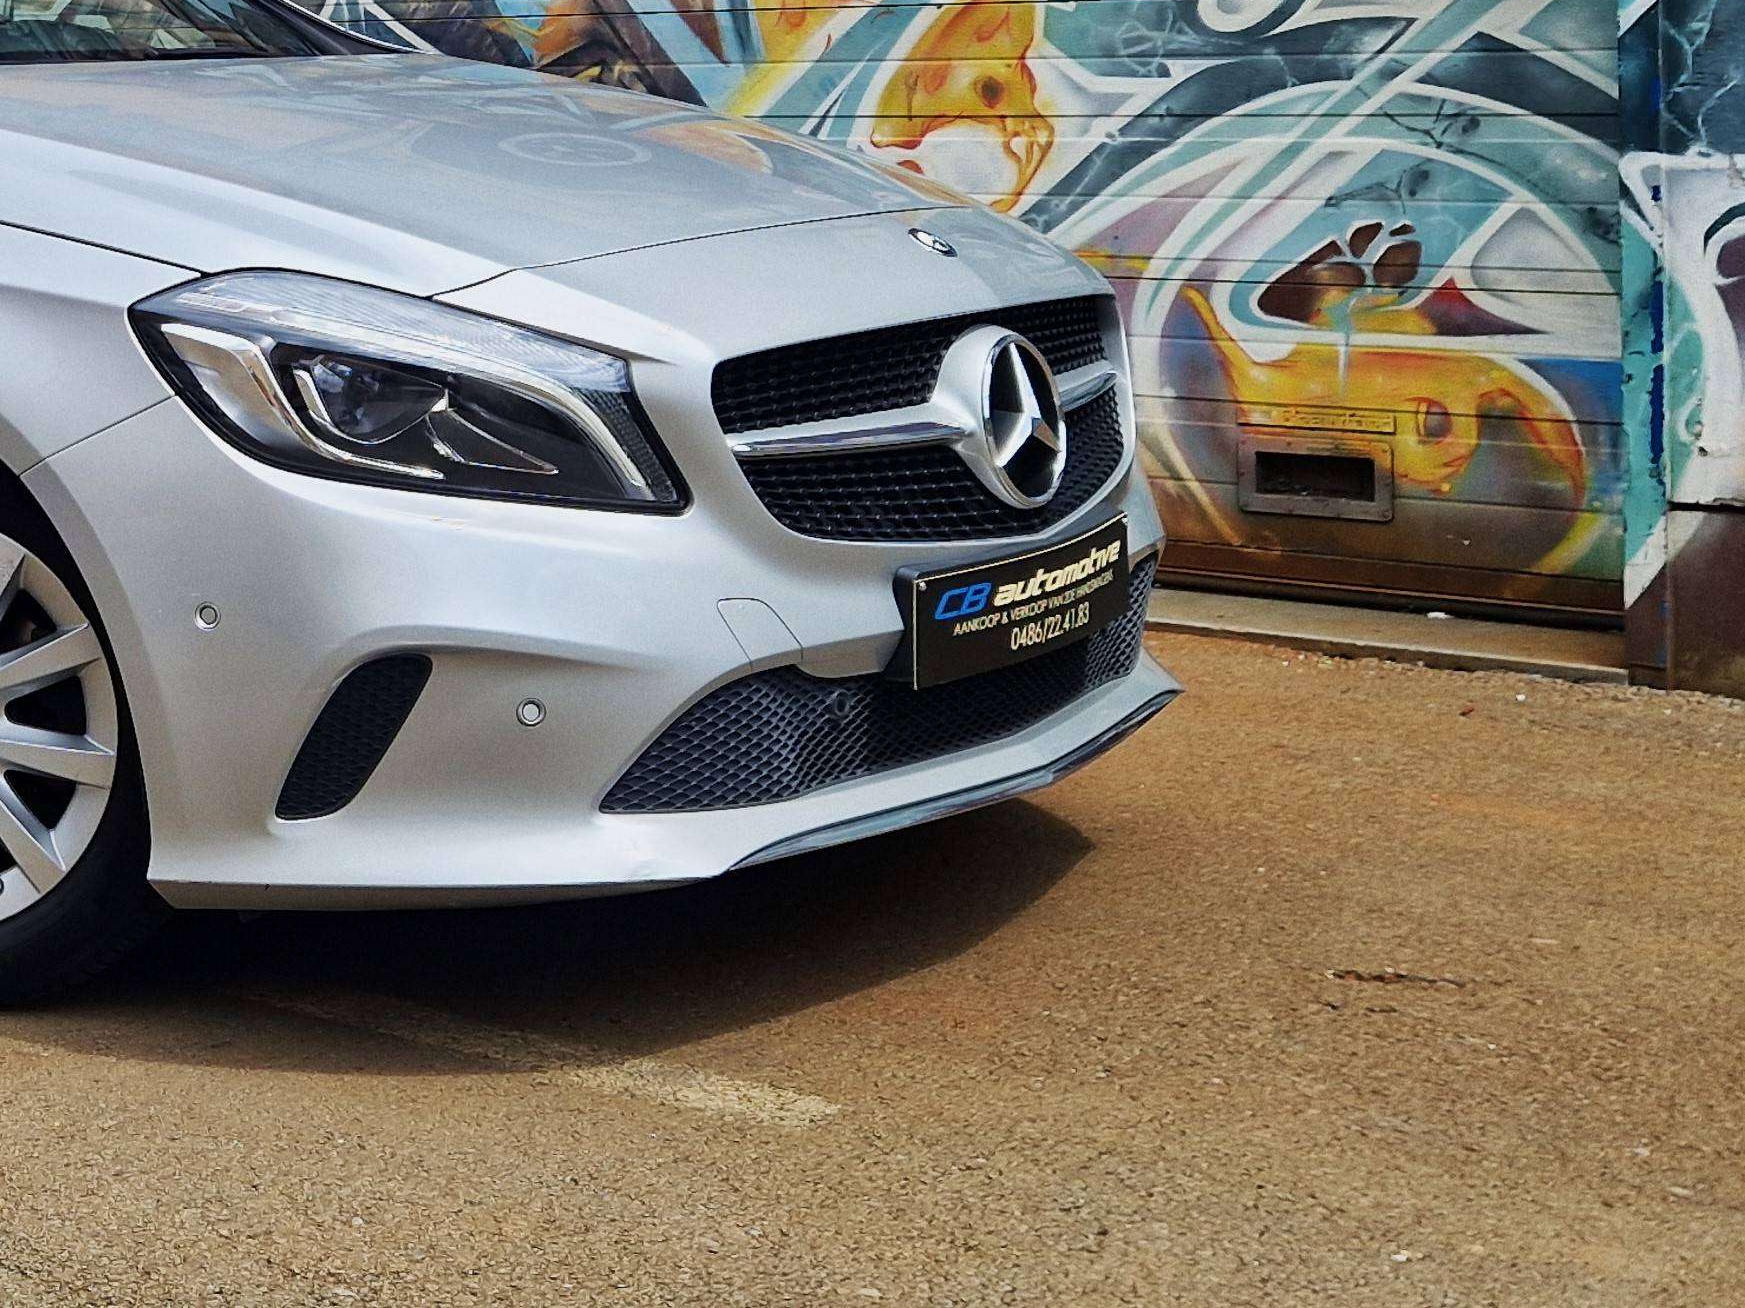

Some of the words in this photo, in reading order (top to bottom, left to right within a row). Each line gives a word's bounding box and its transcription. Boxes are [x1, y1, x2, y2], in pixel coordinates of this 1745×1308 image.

[933, 582, 993, 621] CB
[993, 540, 1121, 607] automotive
[952, 612, 1001, 637] AANKOOP
[1002, 610, 1010, 625] &
